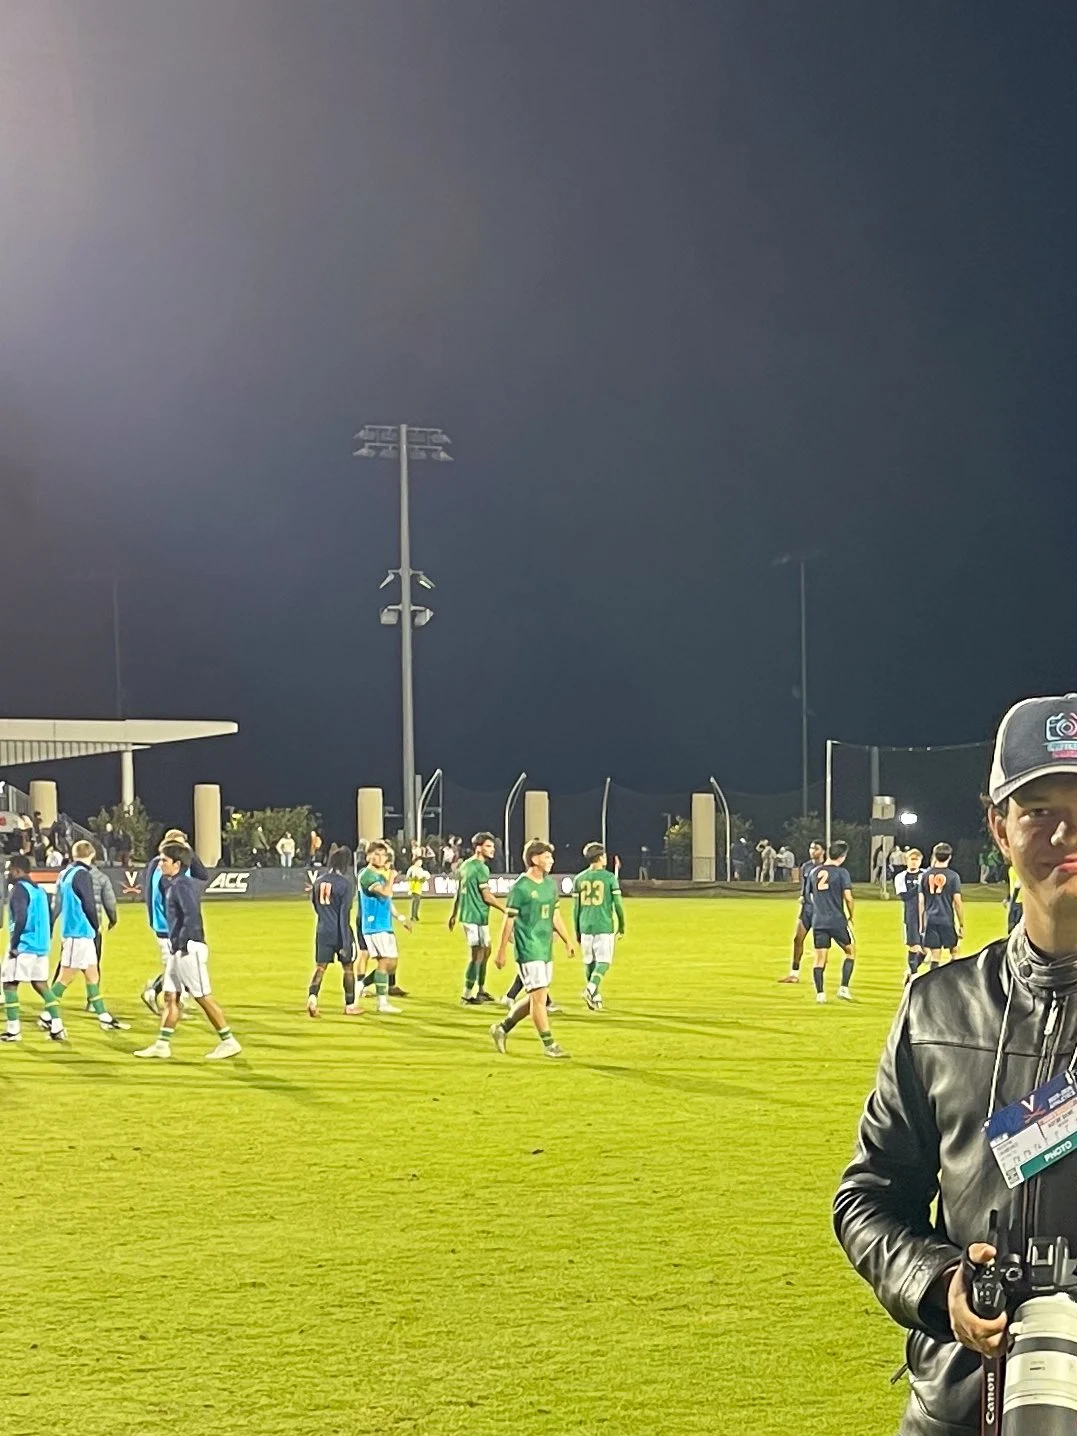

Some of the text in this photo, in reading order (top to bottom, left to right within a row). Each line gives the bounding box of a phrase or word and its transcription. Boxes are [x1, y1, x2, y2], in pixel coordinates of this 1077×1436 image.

[125, 871, 138, 887] V
[209, 872, 250, 889] ACC
[817, 869, 830, 891] 2
[928, 873, 947, 895] 19
[320, 882, 332, 905] 11
[580, 880, 605, 906] 23
[1021, 1094, 1035, 1112] V
[1044, 1140, 1072, 1162] PHOTO
[986, 1372, 995, 1425] Canon
